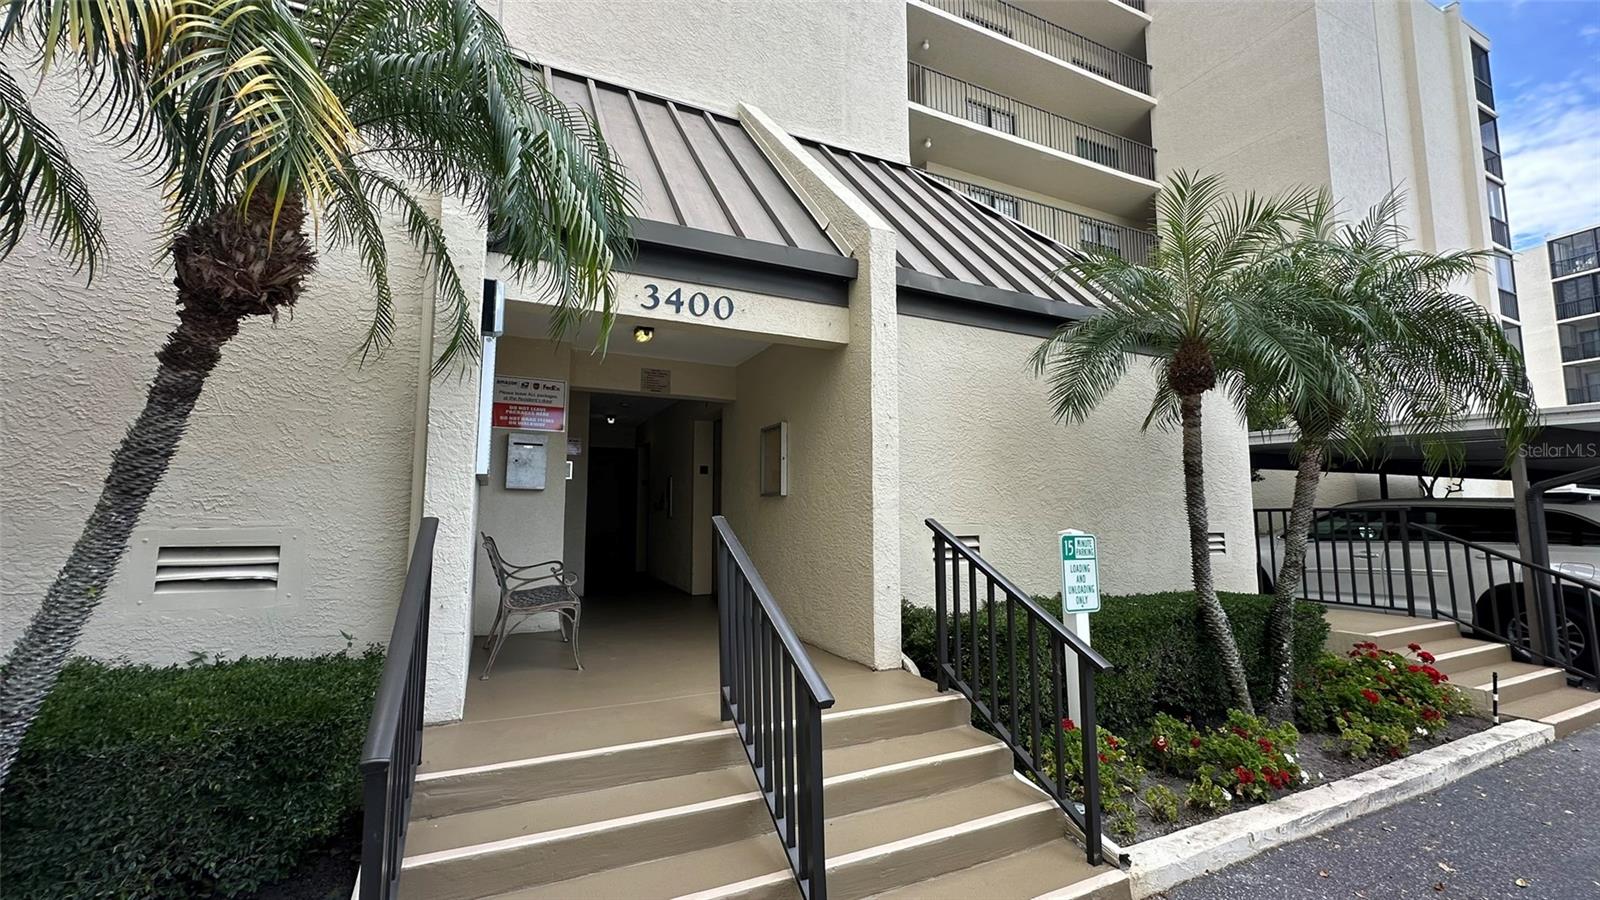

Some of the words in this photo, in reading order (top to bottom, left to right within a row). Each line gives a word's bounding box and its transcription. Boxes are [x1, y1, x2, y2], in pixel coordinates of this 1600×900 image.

[640, 284, 734, 320] 3400
[1064, 540, 1074, 556] 15
[1076, 539, 1093, 548] MINUTE
[1076, 548, 1094, 556] PARKING
[1070, 564, 1091, 574] LOADING
[1076, 574, 1087, 584] AND
[1068, 584, 1095, 595] UNLOADING
[1075, 595, 1088, 605] ONLY
